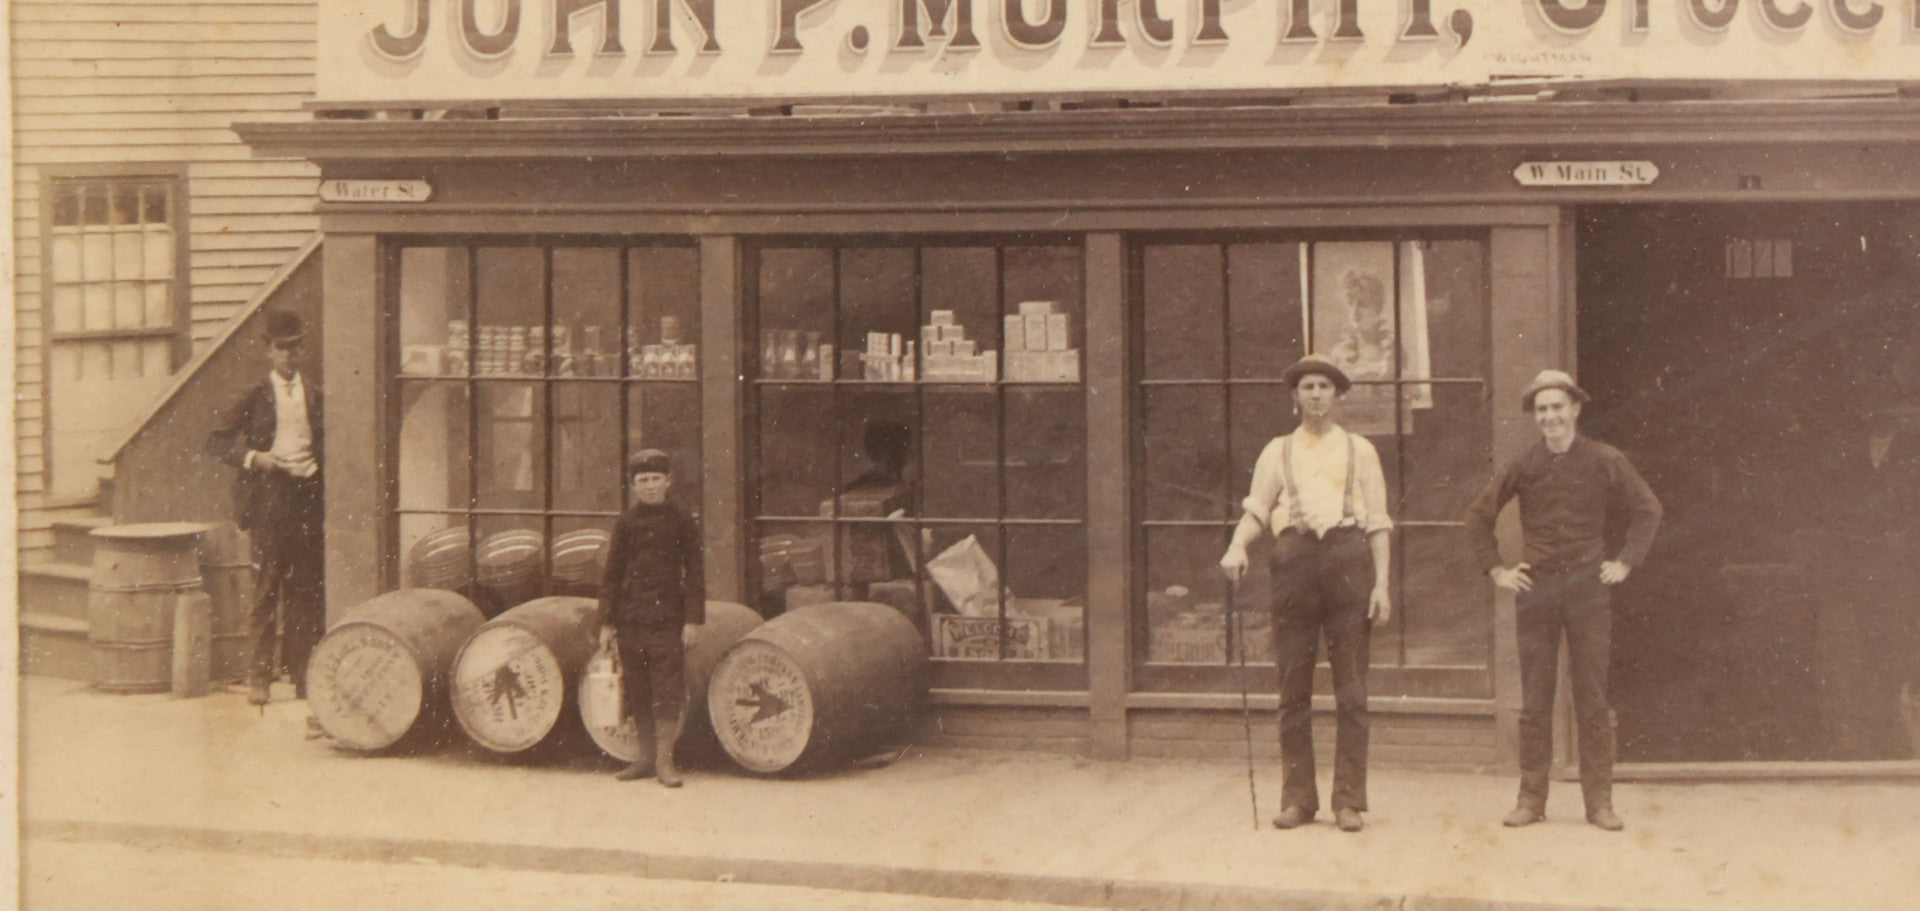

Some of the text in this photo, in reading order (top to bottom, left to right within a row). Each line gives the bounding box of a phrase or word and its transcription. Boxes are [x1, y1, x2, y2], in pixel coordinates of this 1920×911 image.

[1530, 164, 1545, 180] W
[1557, 164, 1607, 181] Main
[334, 181, 390, 198] Water
